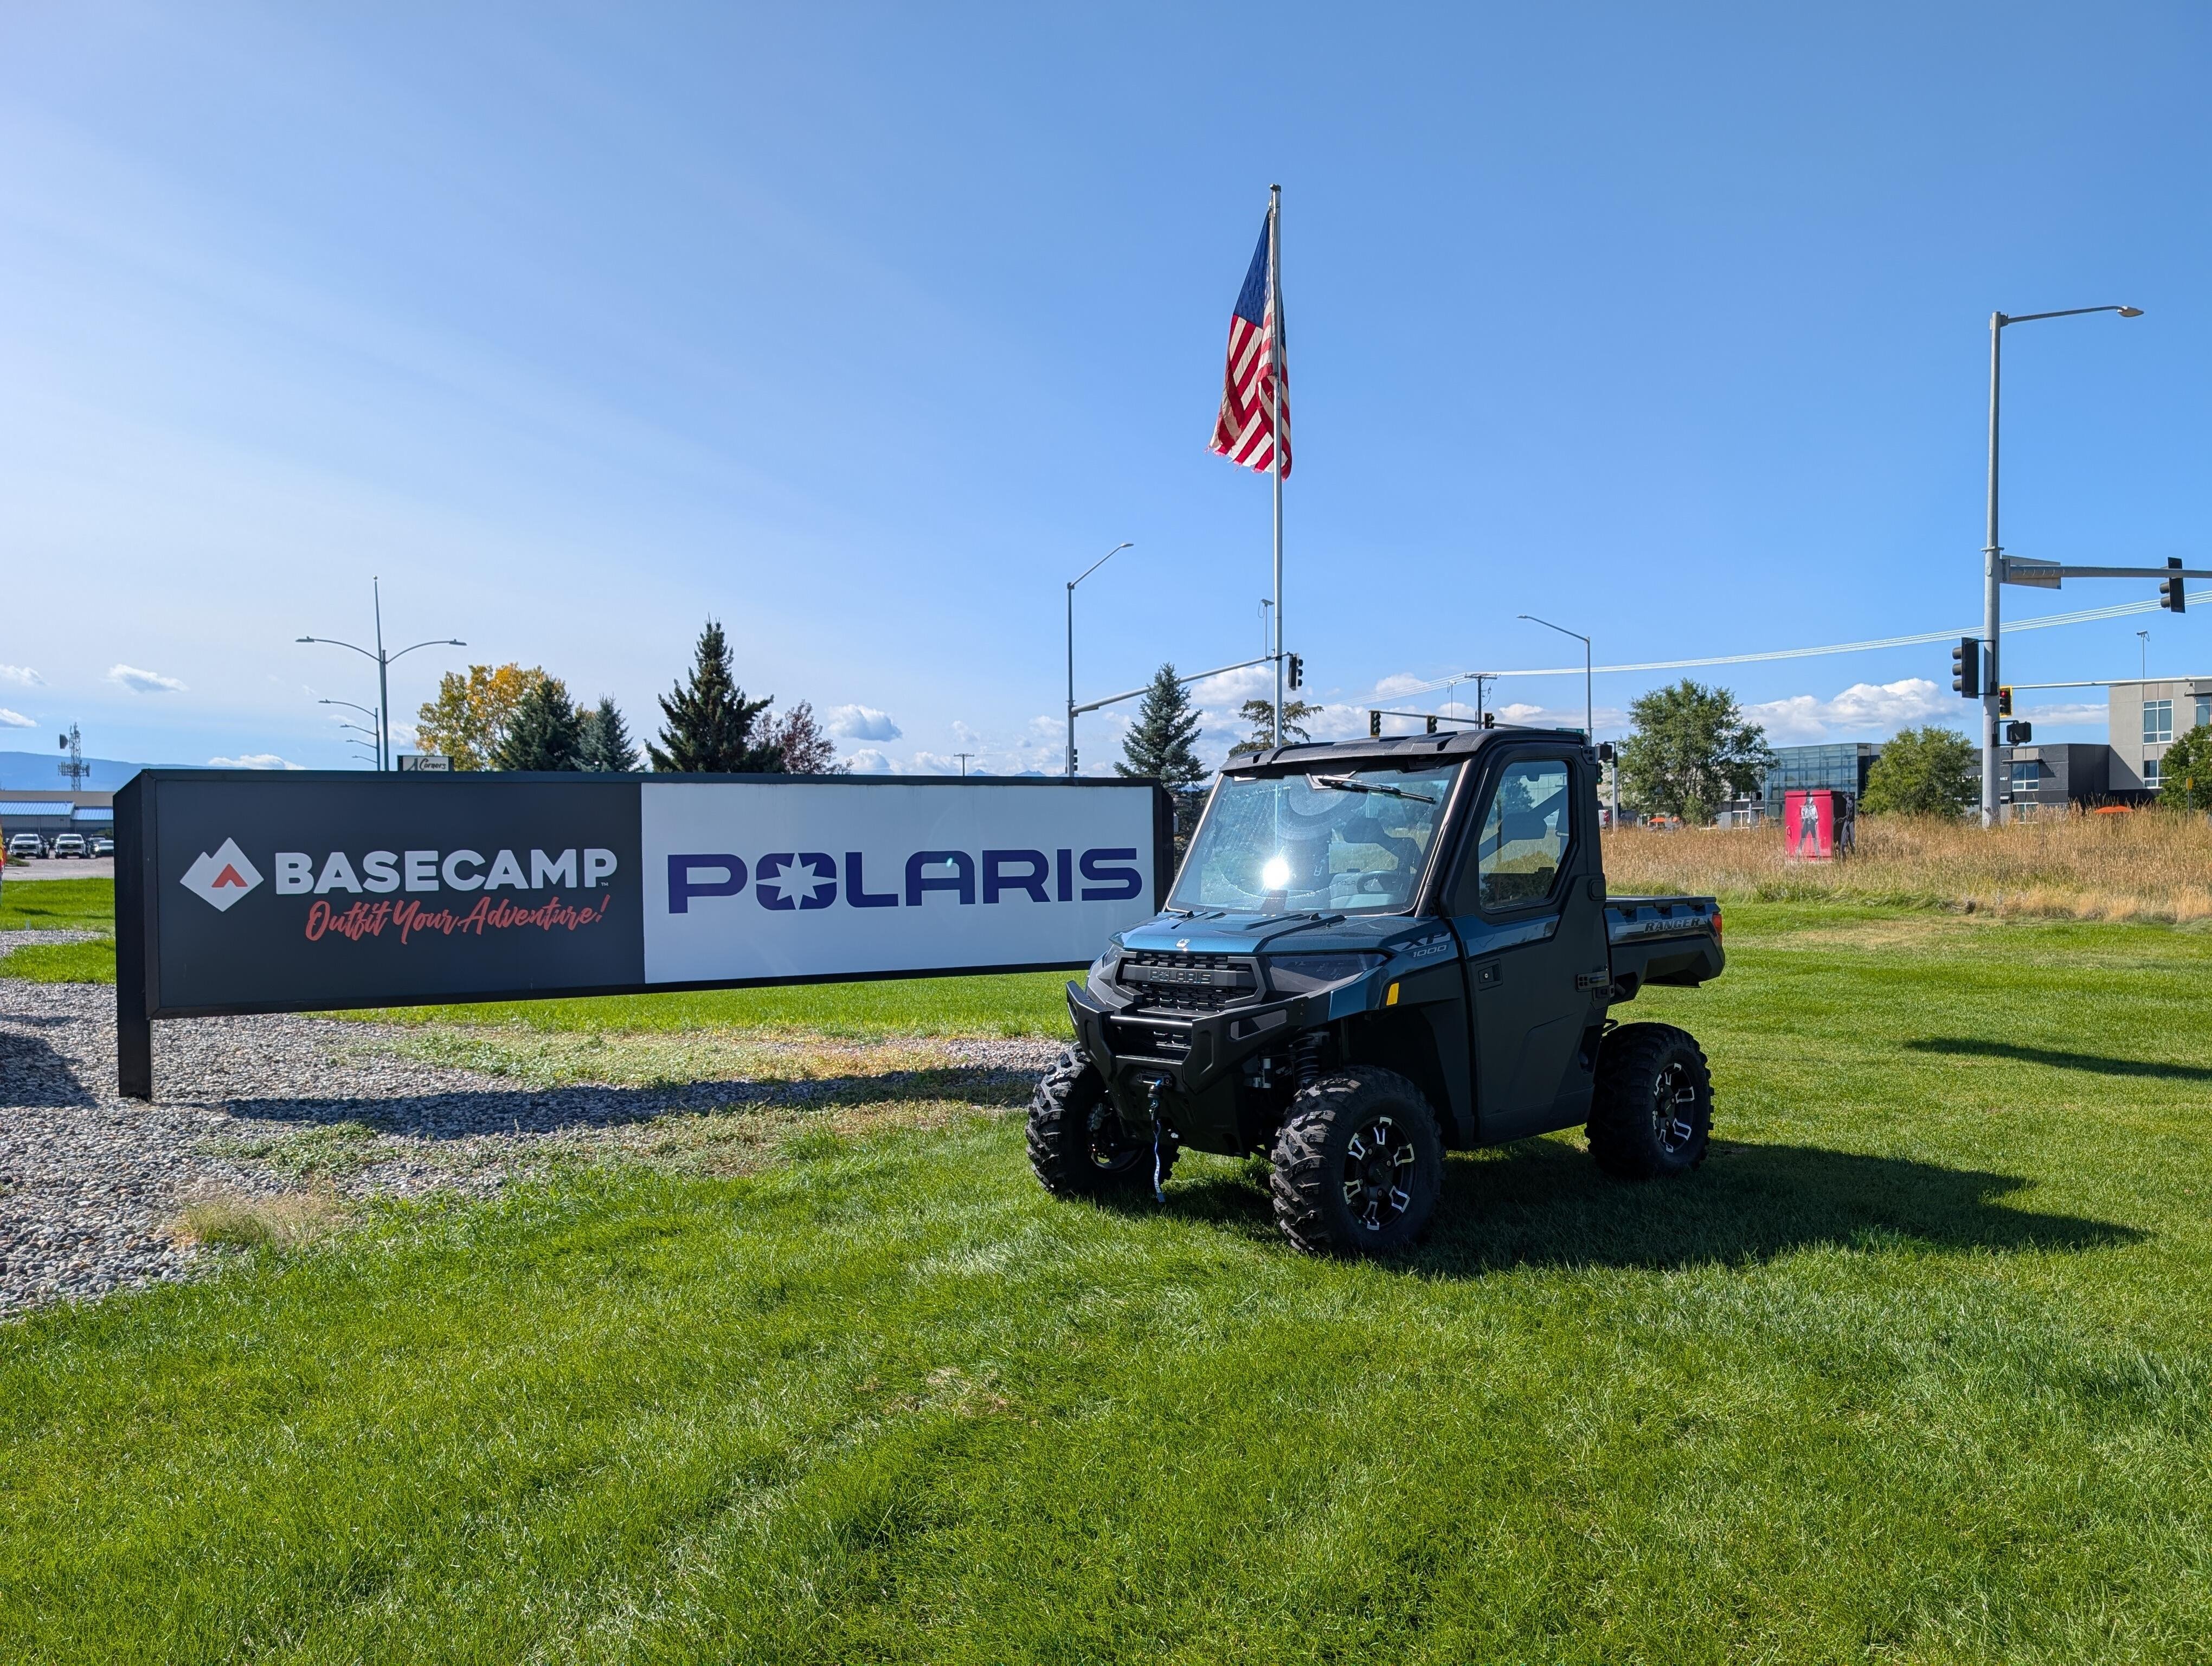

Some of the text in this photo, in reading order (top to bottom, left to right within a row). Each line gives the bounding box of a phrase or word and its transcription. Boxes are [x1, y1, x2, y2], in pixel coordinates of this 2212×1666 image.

[419, 758, 446, 771] Corners
[275, 849, 618, 895] BASECAMP
[667, 848, 1142, 914] POLARIS
[305, 895, 610, 945] Outfit Your Adventure!
[1644, 918, 1700, 933] RANGER
[1401, 931, 1447, 951] XP
[1413, 945, 1446, 958] 1000
[1149, 970, 1211, 984] POLARIS
